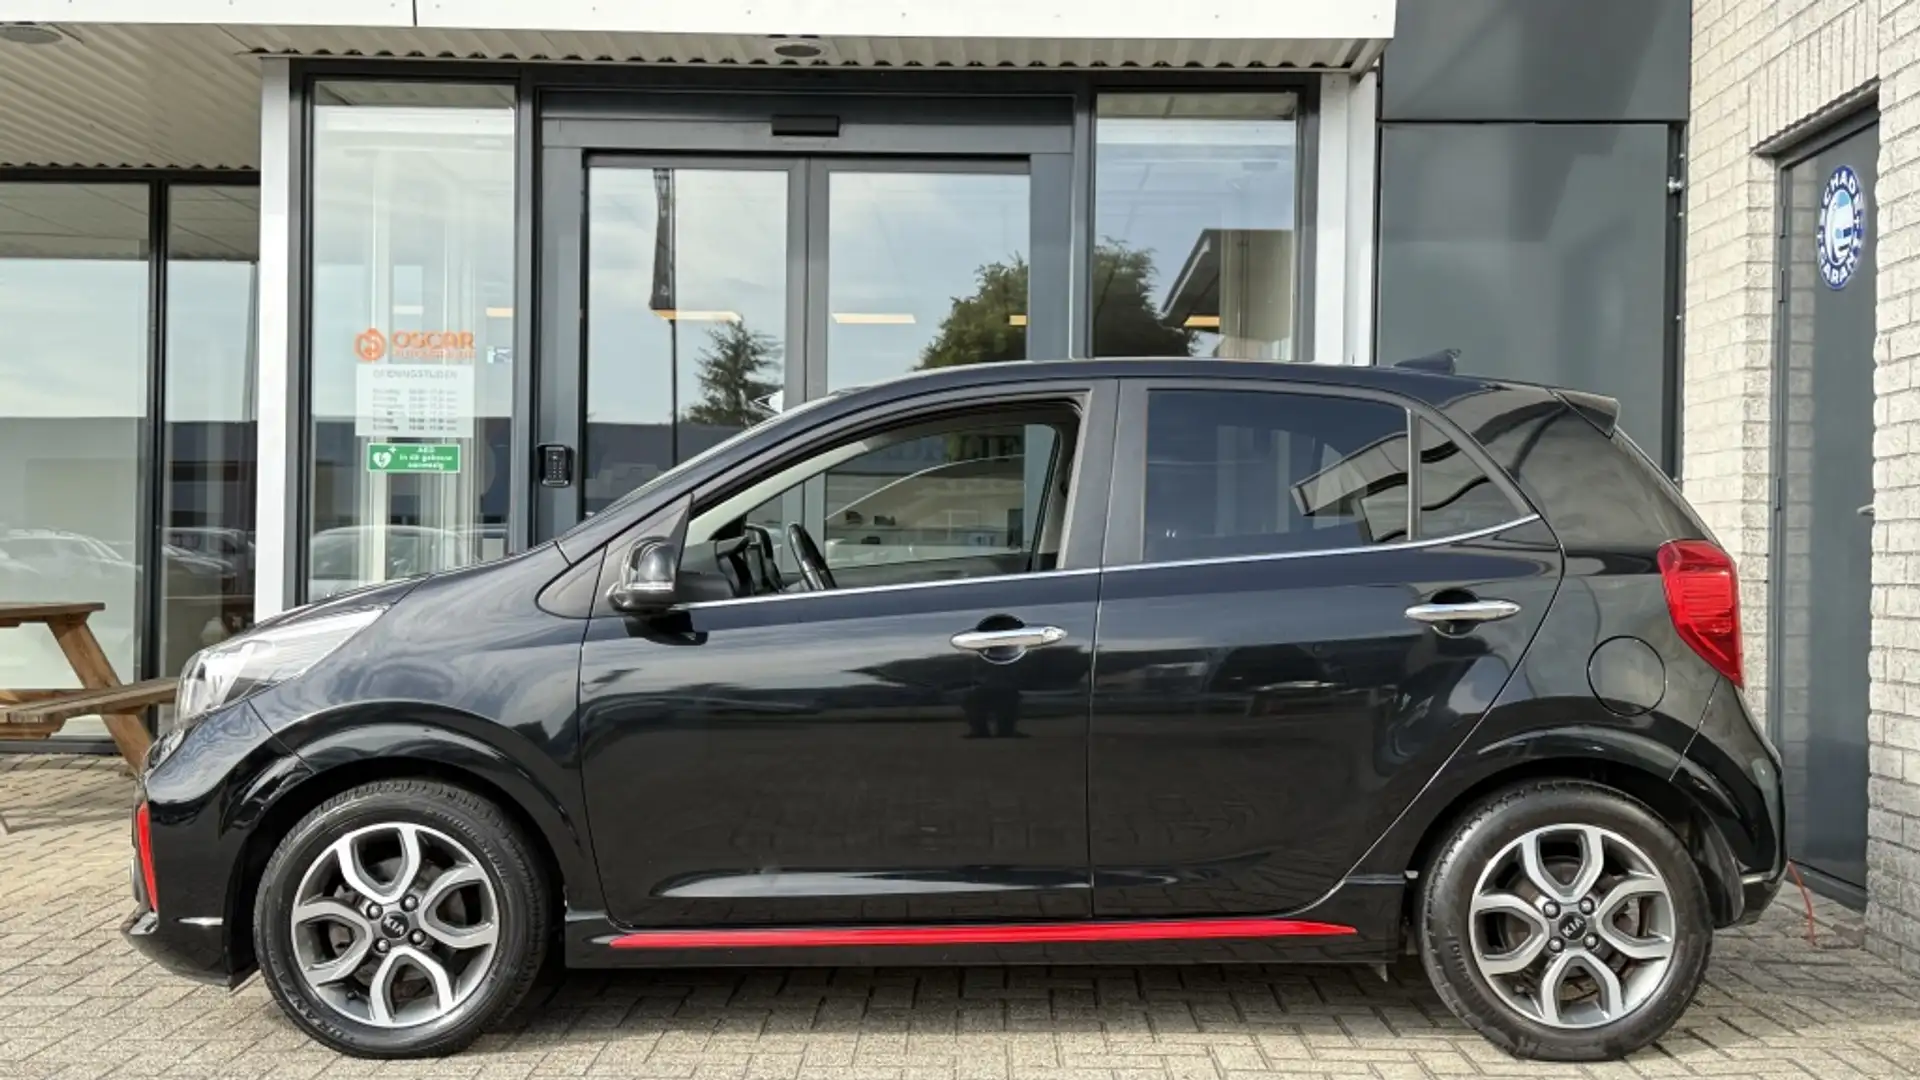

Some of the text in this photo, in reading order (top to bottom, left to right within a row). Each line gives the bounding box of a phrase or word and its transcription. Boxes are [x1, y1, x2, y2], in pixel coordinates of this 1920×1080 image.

[391, 330, 475, 350] OSCAR
[383, 915, 405, 935] KIA
[1562, 917, 1584, 937] KIA
